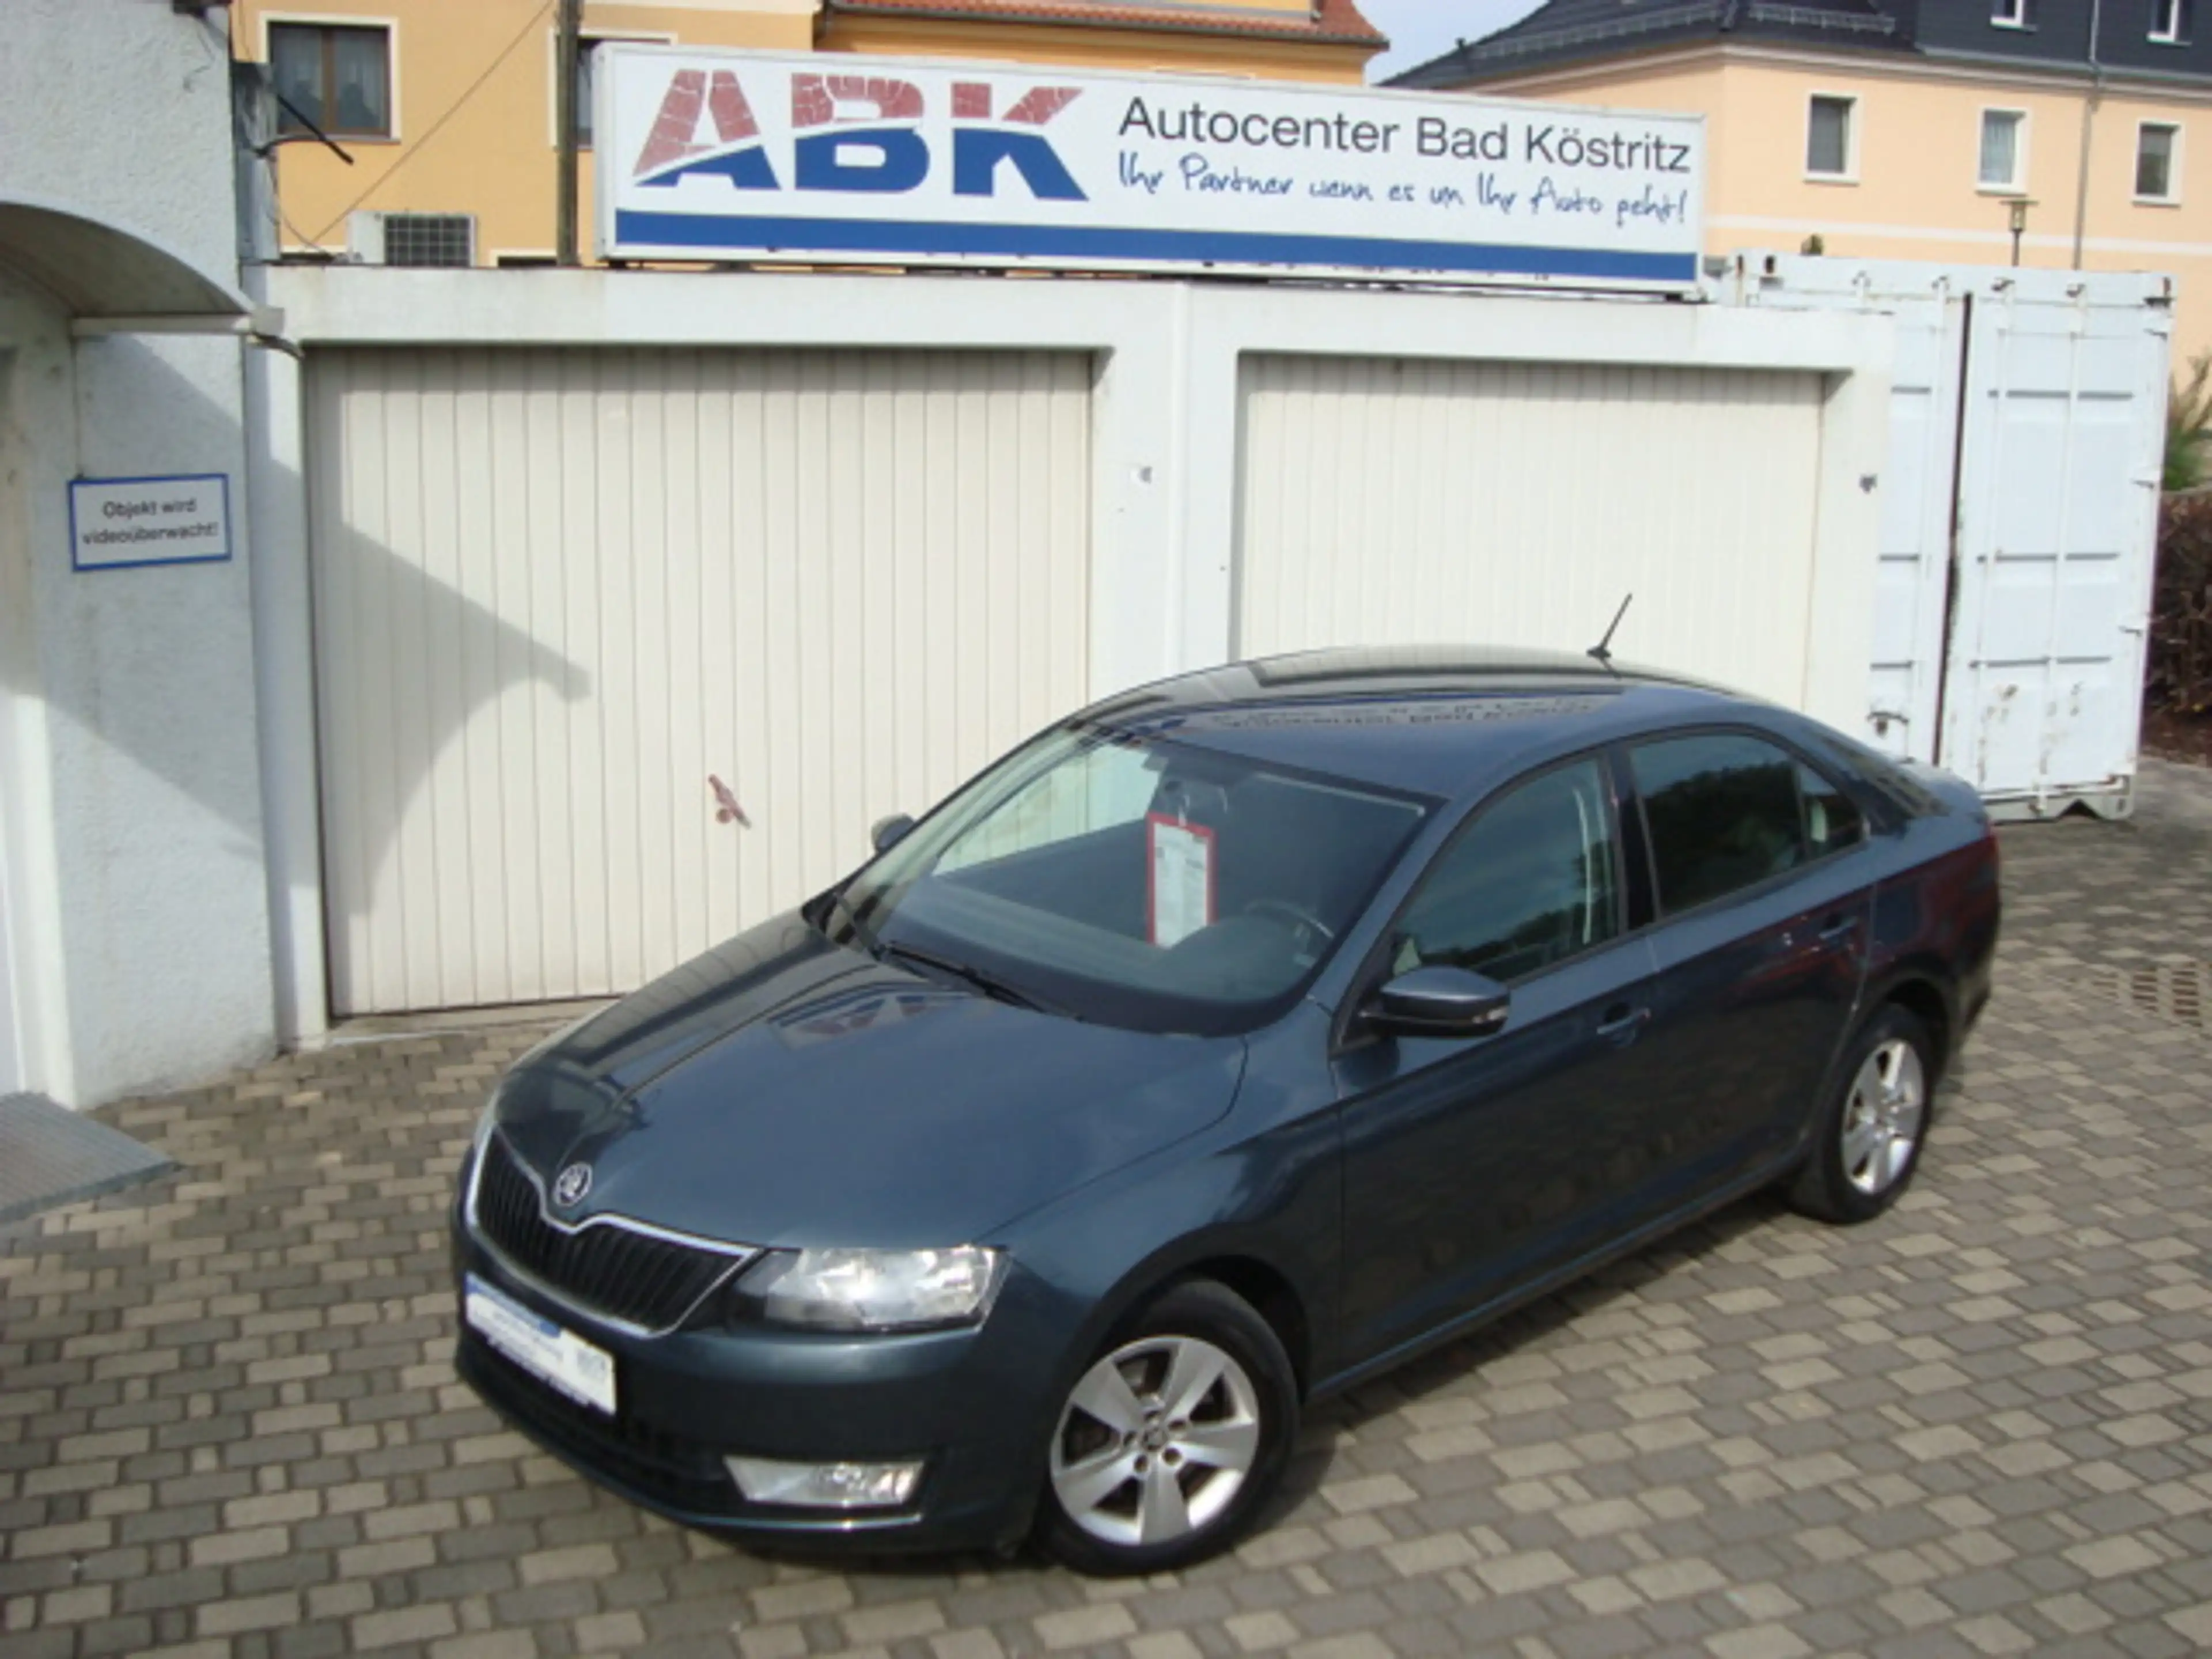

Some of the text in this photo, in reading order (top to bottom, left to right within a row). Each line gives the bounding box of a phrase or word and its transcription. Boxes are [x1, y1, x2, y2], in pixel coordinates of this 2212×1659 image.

[633, 69, 1089, 202] ABK
[1119, 96, 1691, 174] Autocenter Bad Köstritz
[1119, 150, 1164, 195] Ihr
[1179, 151, 1295, 196] Partner
[1308, 180, 1373, 201] wenn
[1387, 183, 1416, 203] es
[1429, 185, 1467, 209] um
[1476, 171, 1517, 215] Ihr
[1528, 175, 1604, 215] Auto
[102, 500, 158, 520] Objekt
